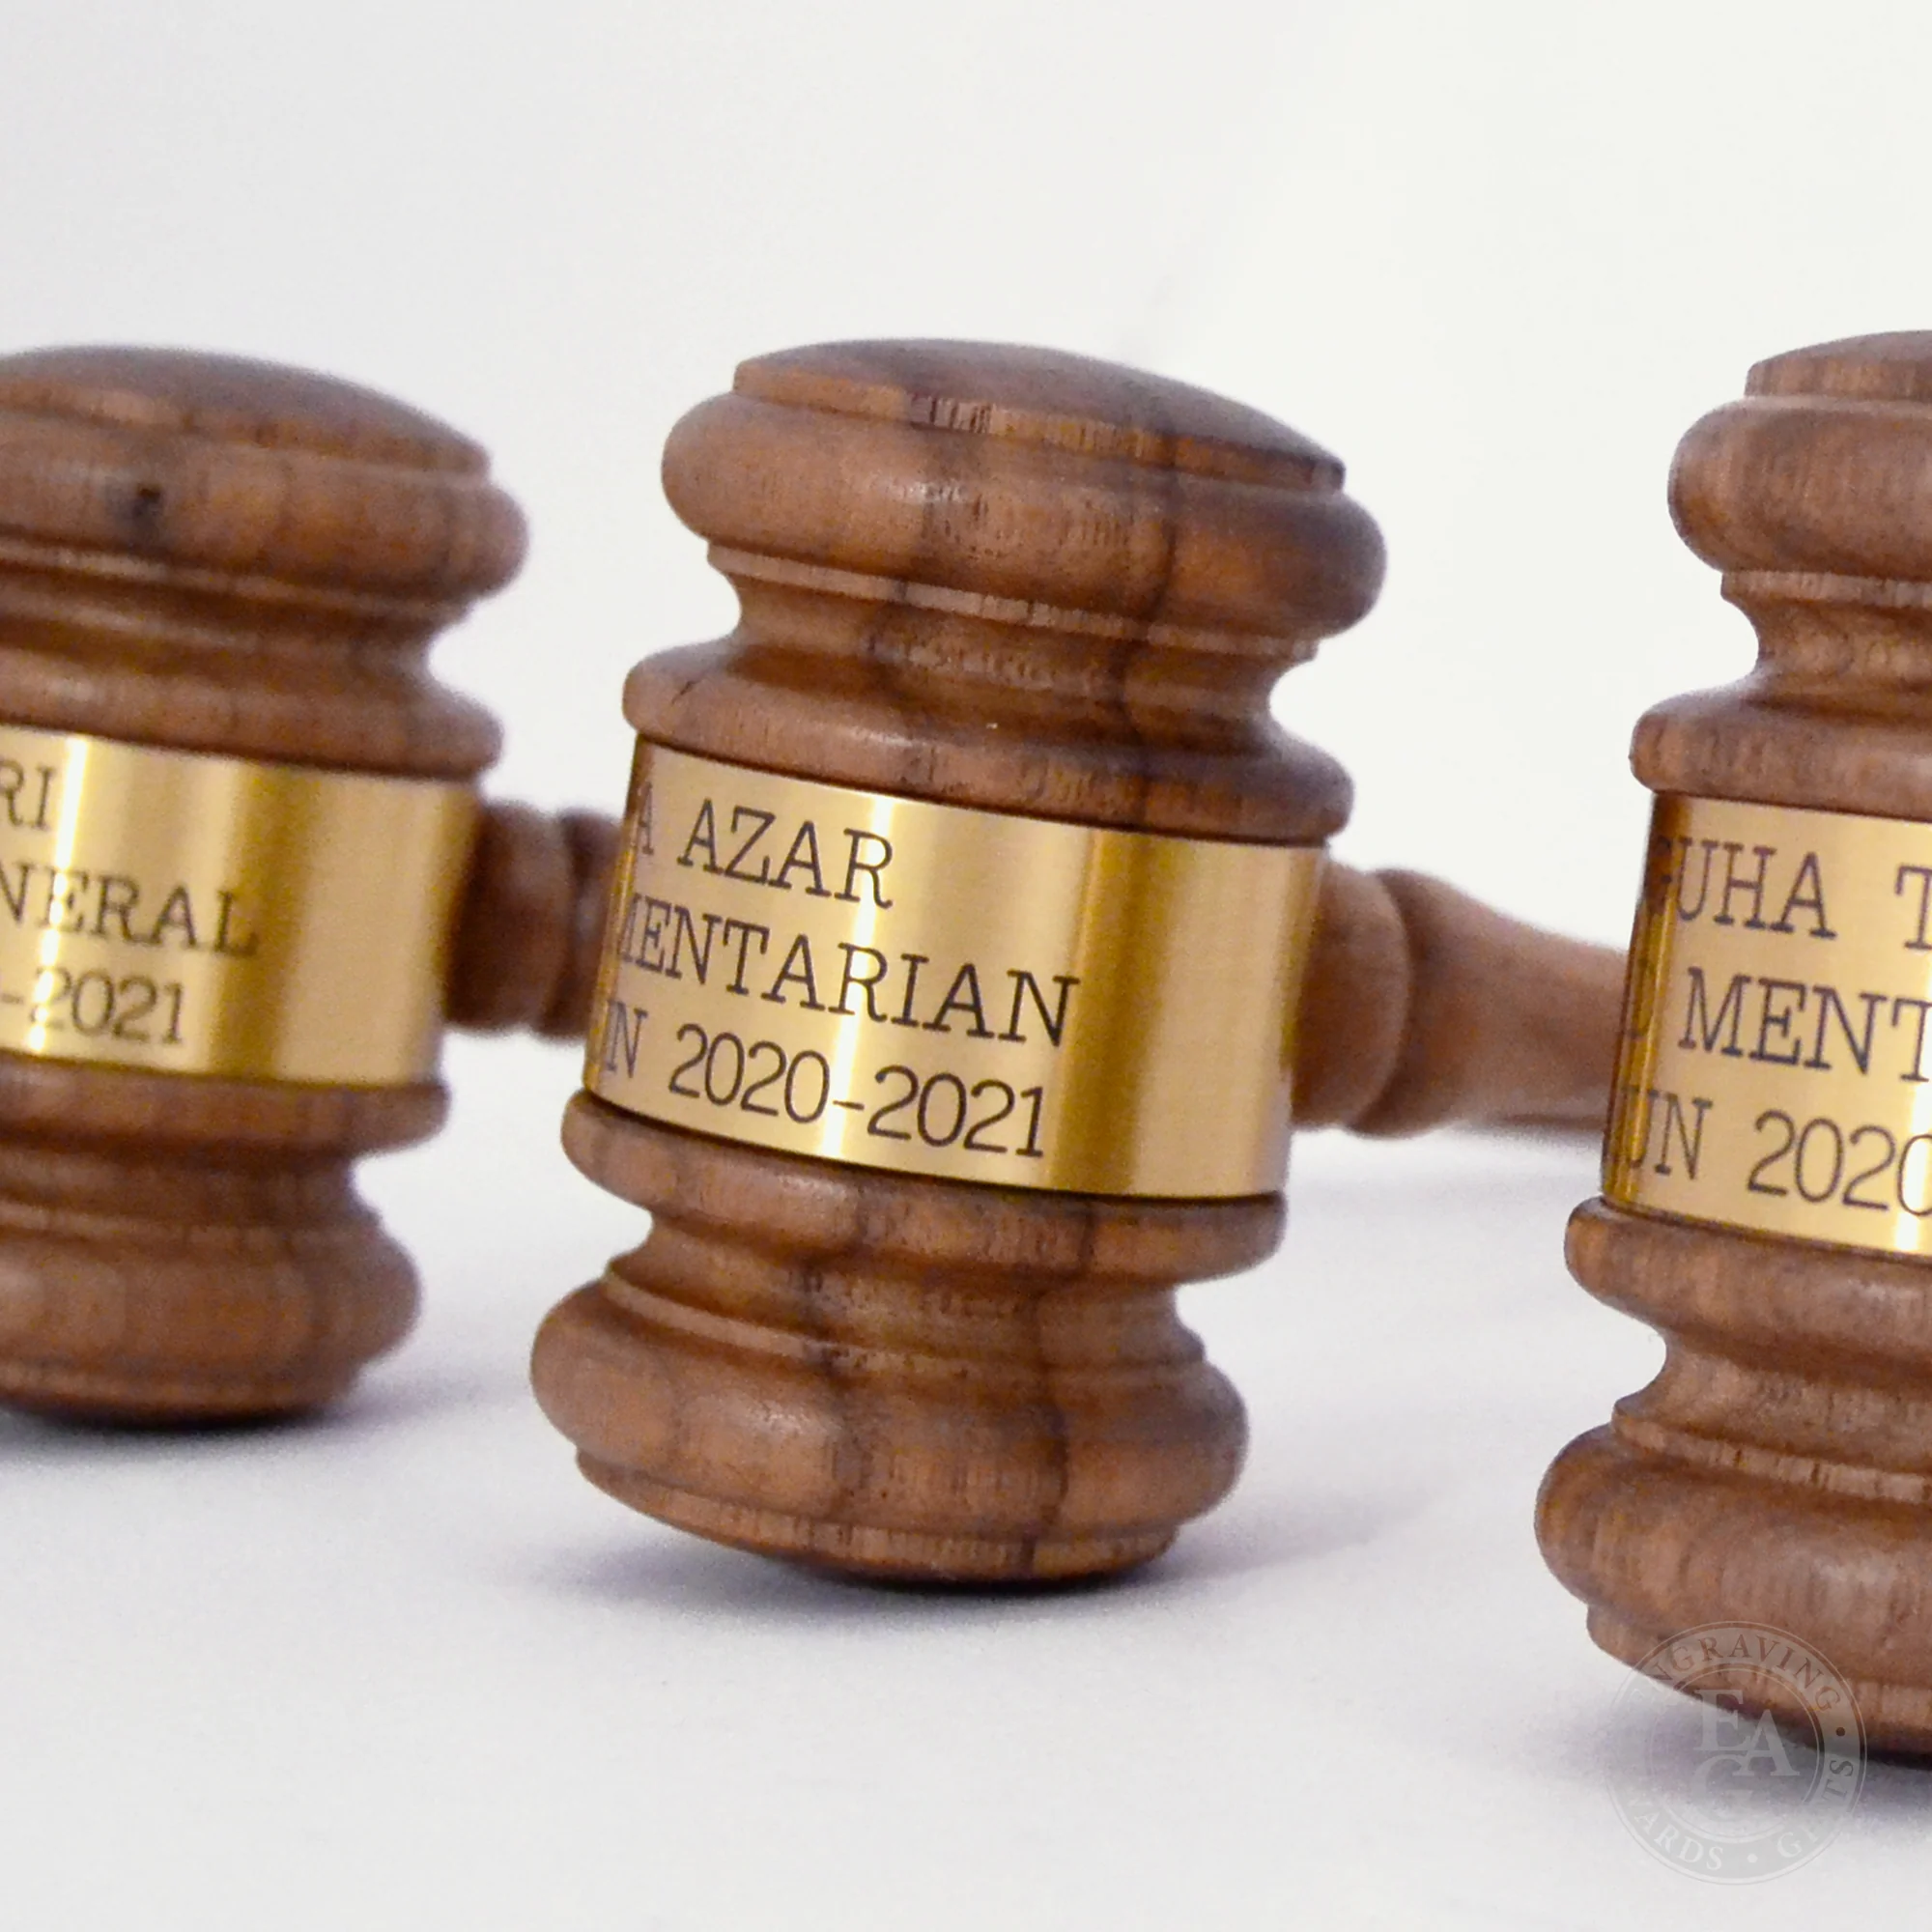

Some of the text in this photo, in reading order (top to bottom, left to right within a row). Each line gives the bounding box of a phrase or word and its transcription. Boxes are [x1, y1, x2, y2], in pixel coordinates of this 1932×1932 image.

[677, 799, 895, 909] AZAR
[1657, 837, 1836, 939] UHA
[668, 1023, 1044, 1159] 2020-2021
